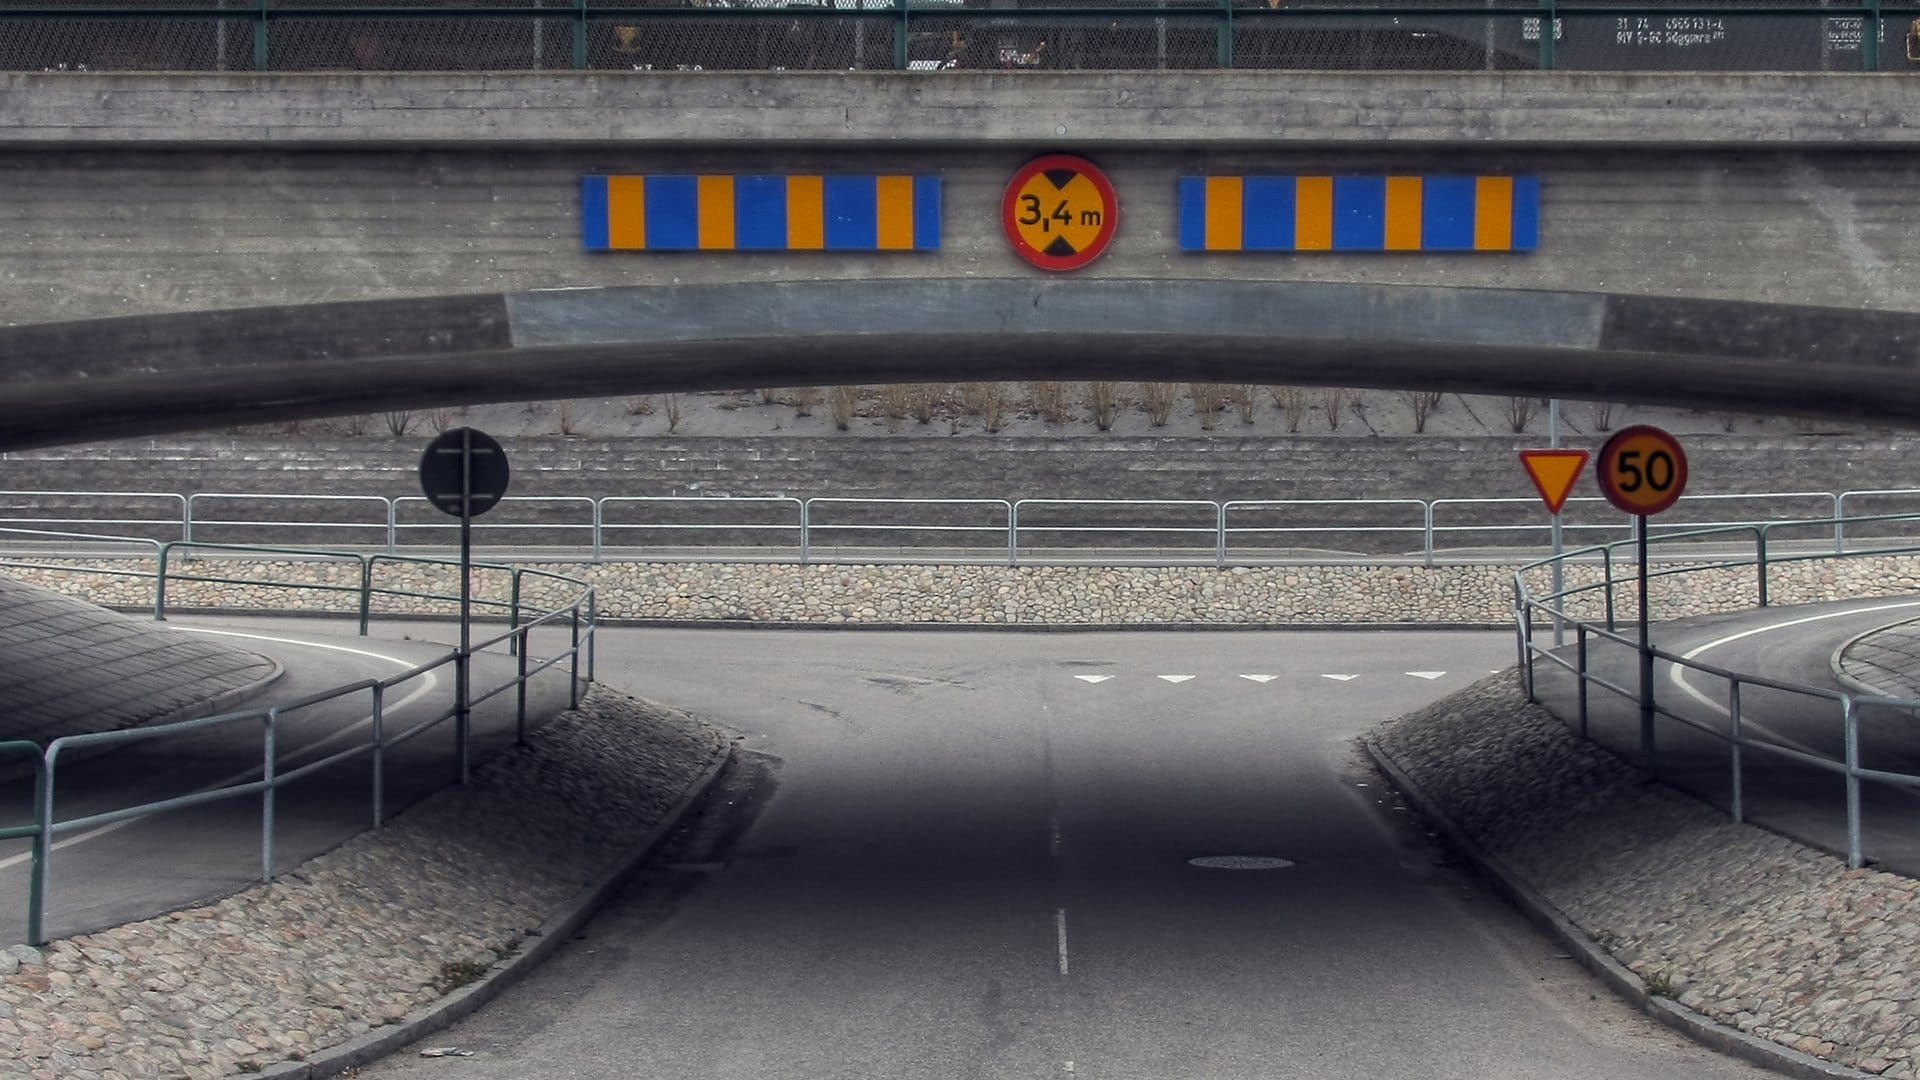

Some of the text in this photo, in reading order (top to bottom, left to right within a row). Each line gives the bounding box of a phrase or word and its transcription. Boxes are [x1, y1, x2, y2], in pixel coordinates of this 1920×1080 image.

[1617, 18, 1628, 29] 31
[1018, 194, 1101, 232] 3,4 m
[1618, 450, 1674, 492] 50
